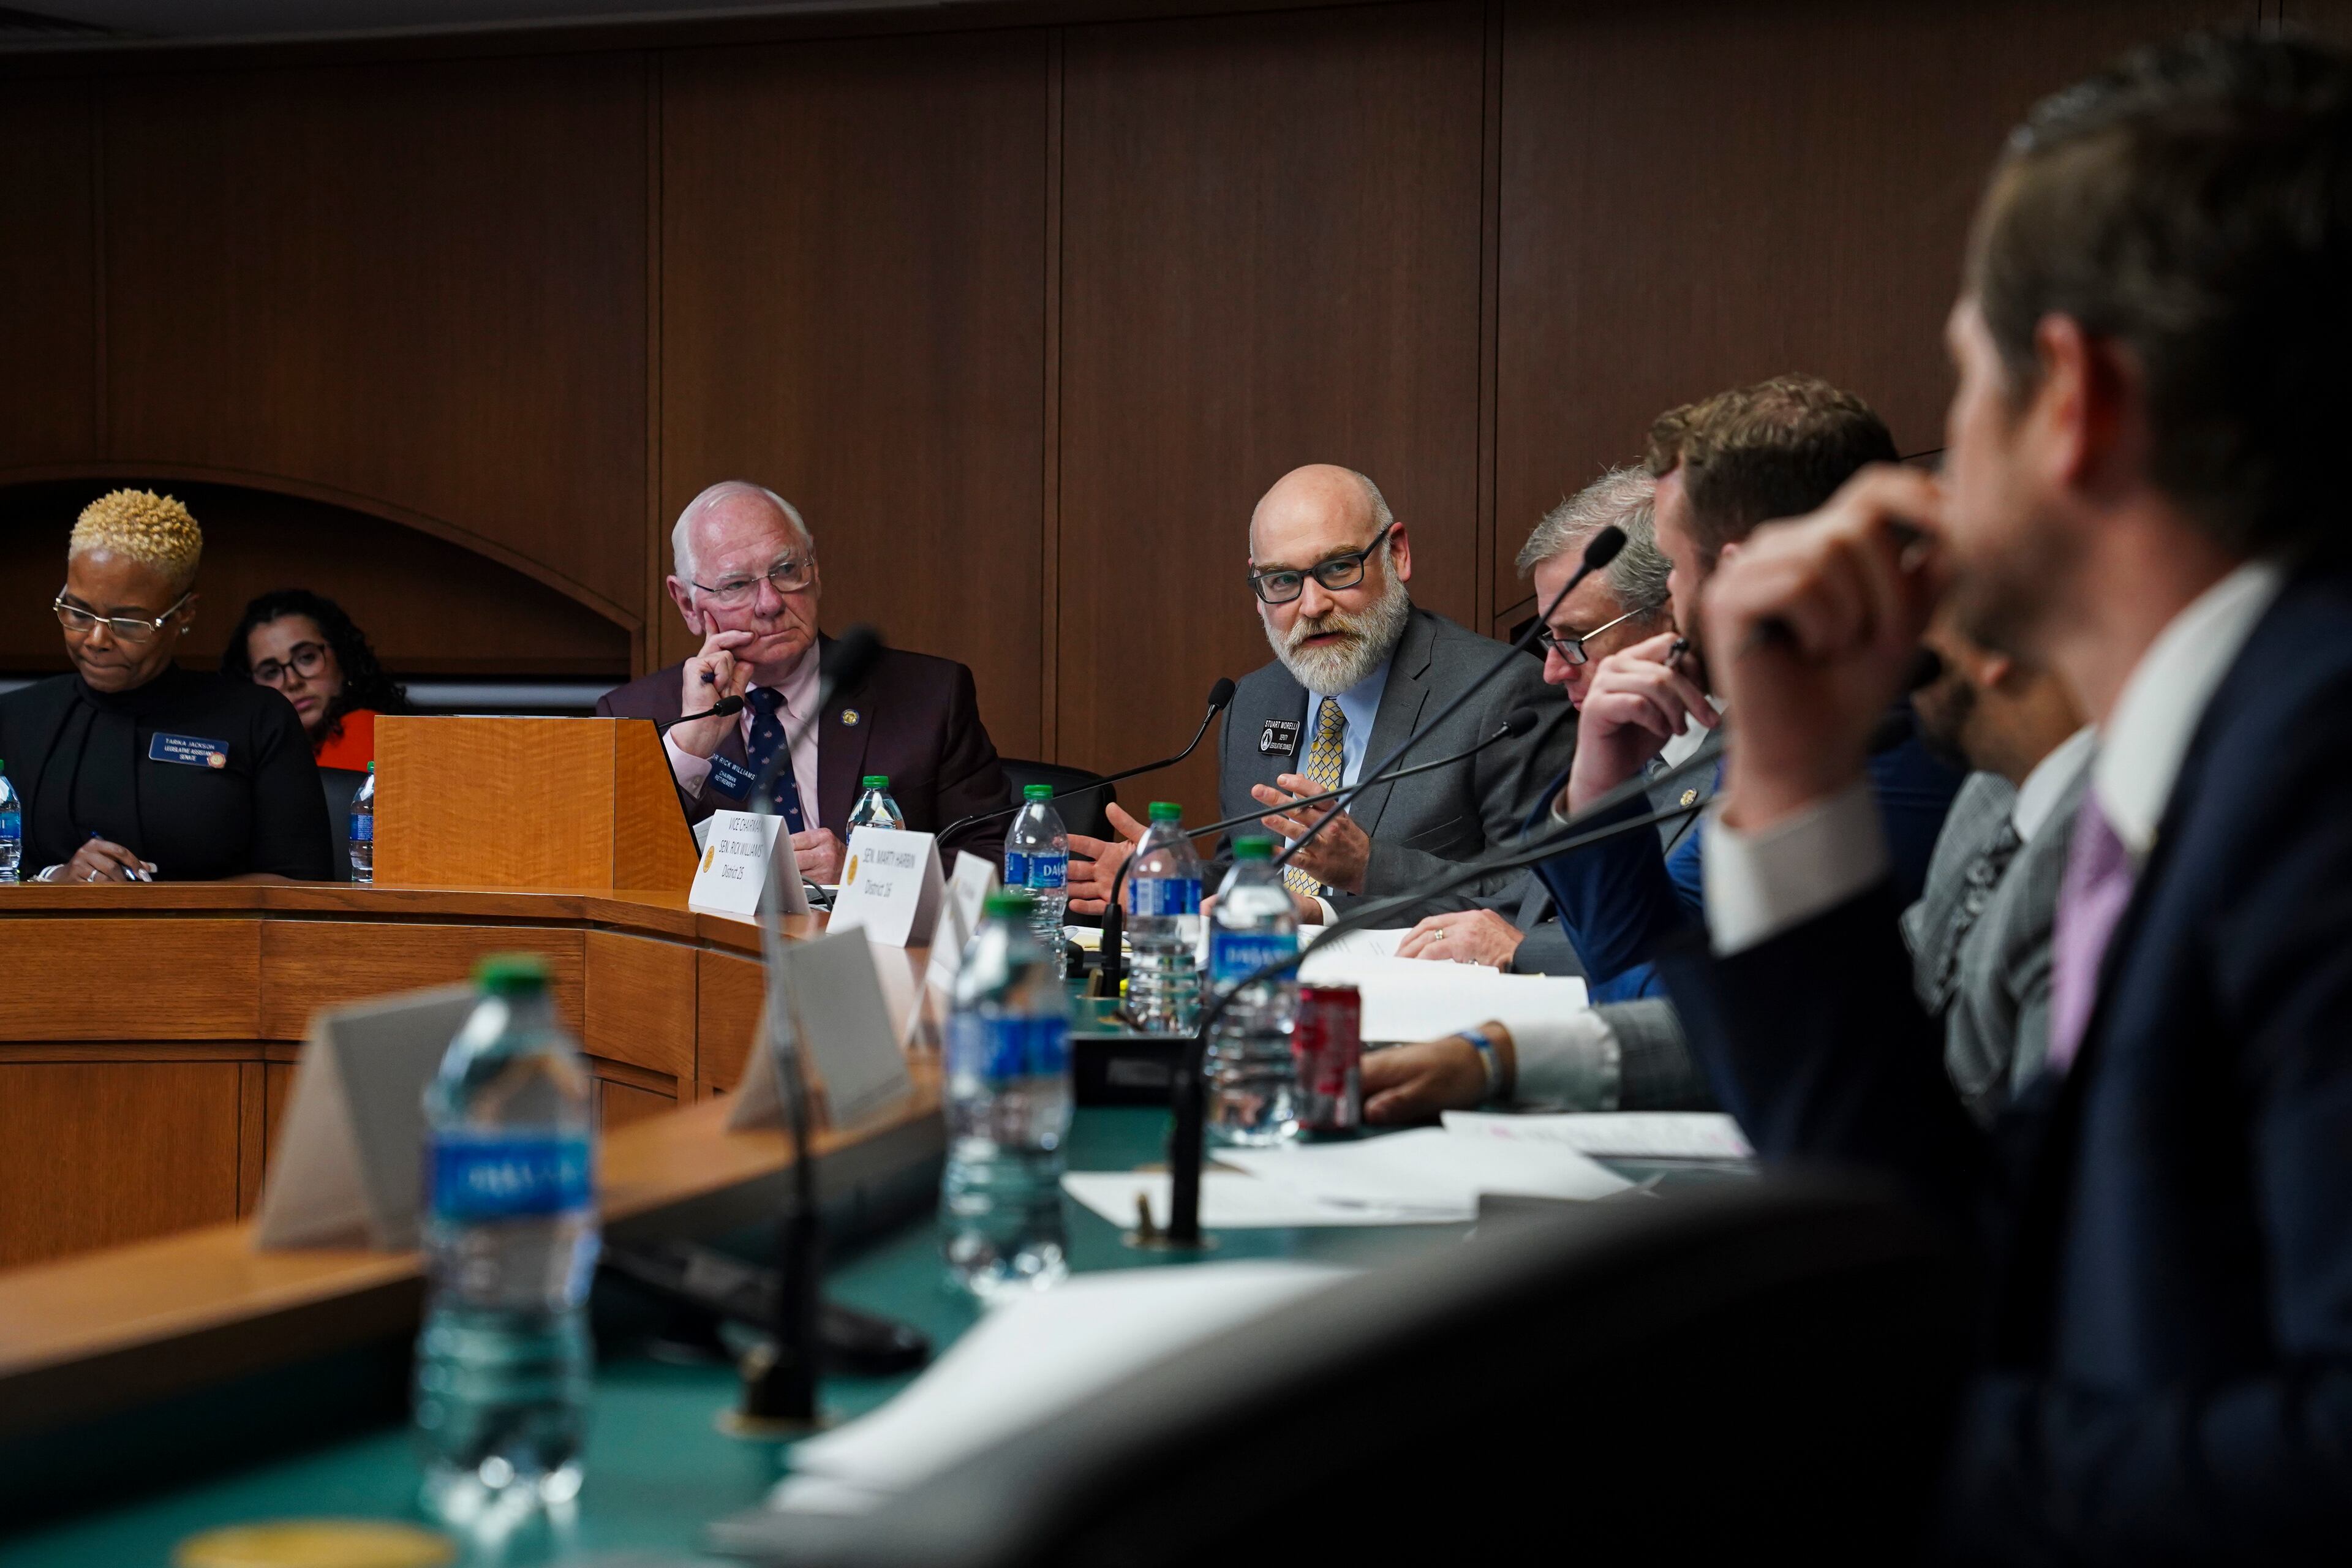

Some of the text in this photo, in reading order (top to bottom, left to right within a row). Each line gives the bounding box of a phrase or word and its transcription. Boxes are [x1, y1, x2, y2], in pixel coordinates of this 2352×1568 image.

[718, 757, 732, 767] RICK
[732, 764, 756, 780] WILLIAMS
[714, 774, 736, 789] RETIREMENT
[719, 771, 736, 783] CHAIRMAN
[729, 818, 764, 832] VICE CHAIRMAN
[719, 840, 764, 857] SEN. RICK WILLIAMS
[722, 864, 744, 880] District 25
[864, 880, 884, 896] District
